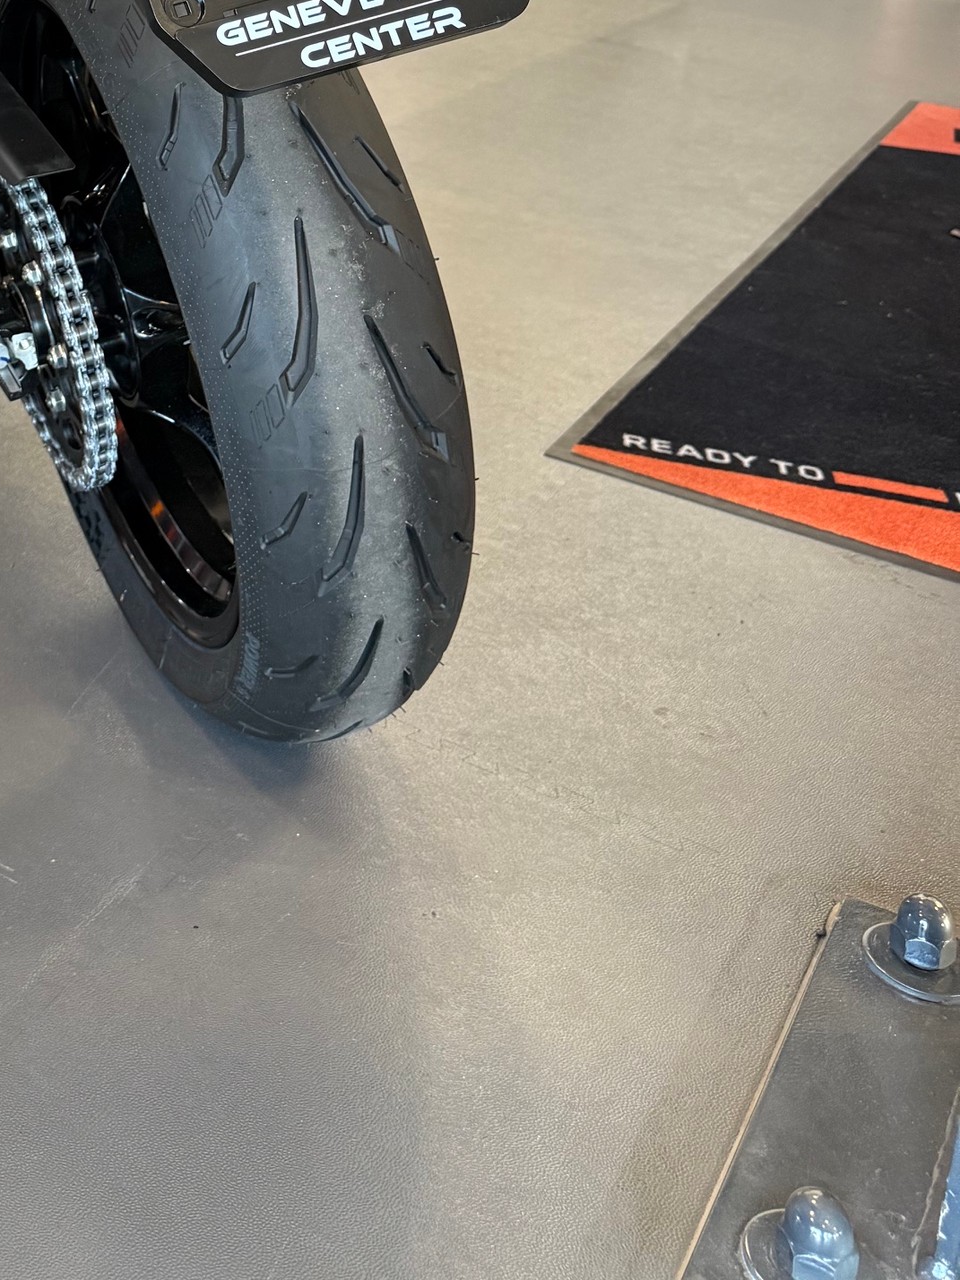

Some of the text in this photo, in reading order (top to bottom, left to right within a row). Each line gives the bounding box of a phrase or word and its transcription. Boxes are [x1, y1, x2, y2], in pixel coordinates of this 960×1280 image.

[300, 6, 466, 68] CENTER
[621, 432, 825, 481] READY TO
